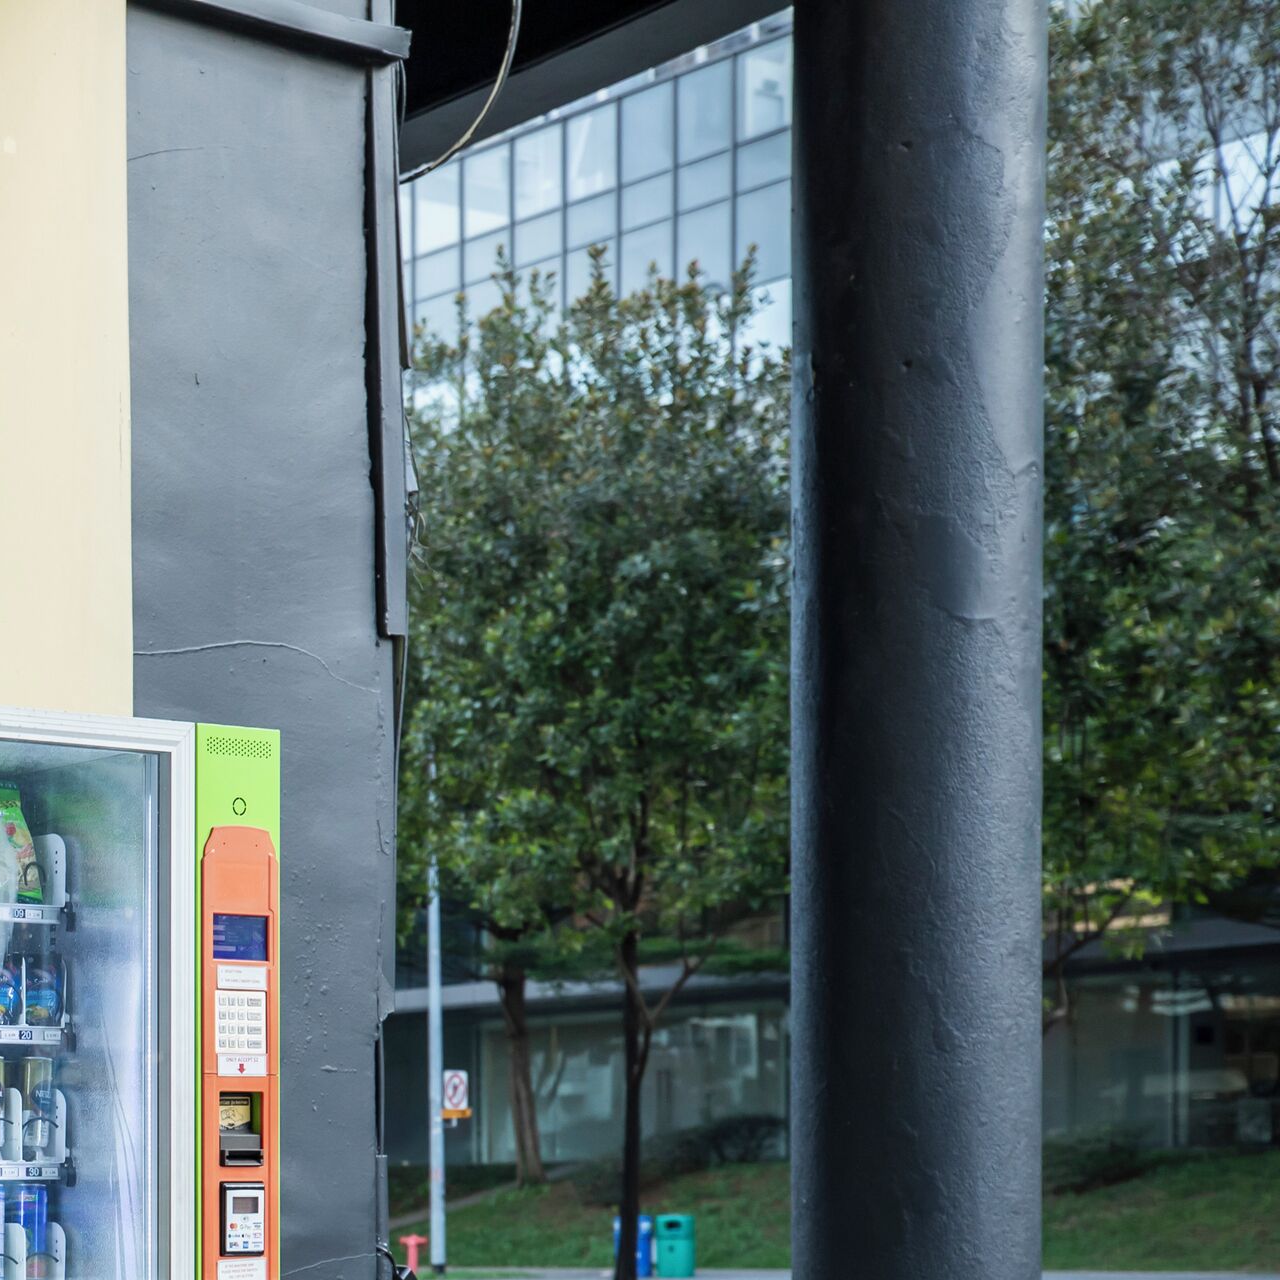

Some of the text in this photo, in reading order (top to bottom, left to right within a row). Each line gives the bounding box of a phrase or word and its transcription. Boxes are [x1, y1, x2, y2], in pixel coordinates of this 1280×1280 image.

[14, 909, 24, 918] 09
[21, 1031, 32, 1040] 20
[28, 1168, 40, 1176] 30
